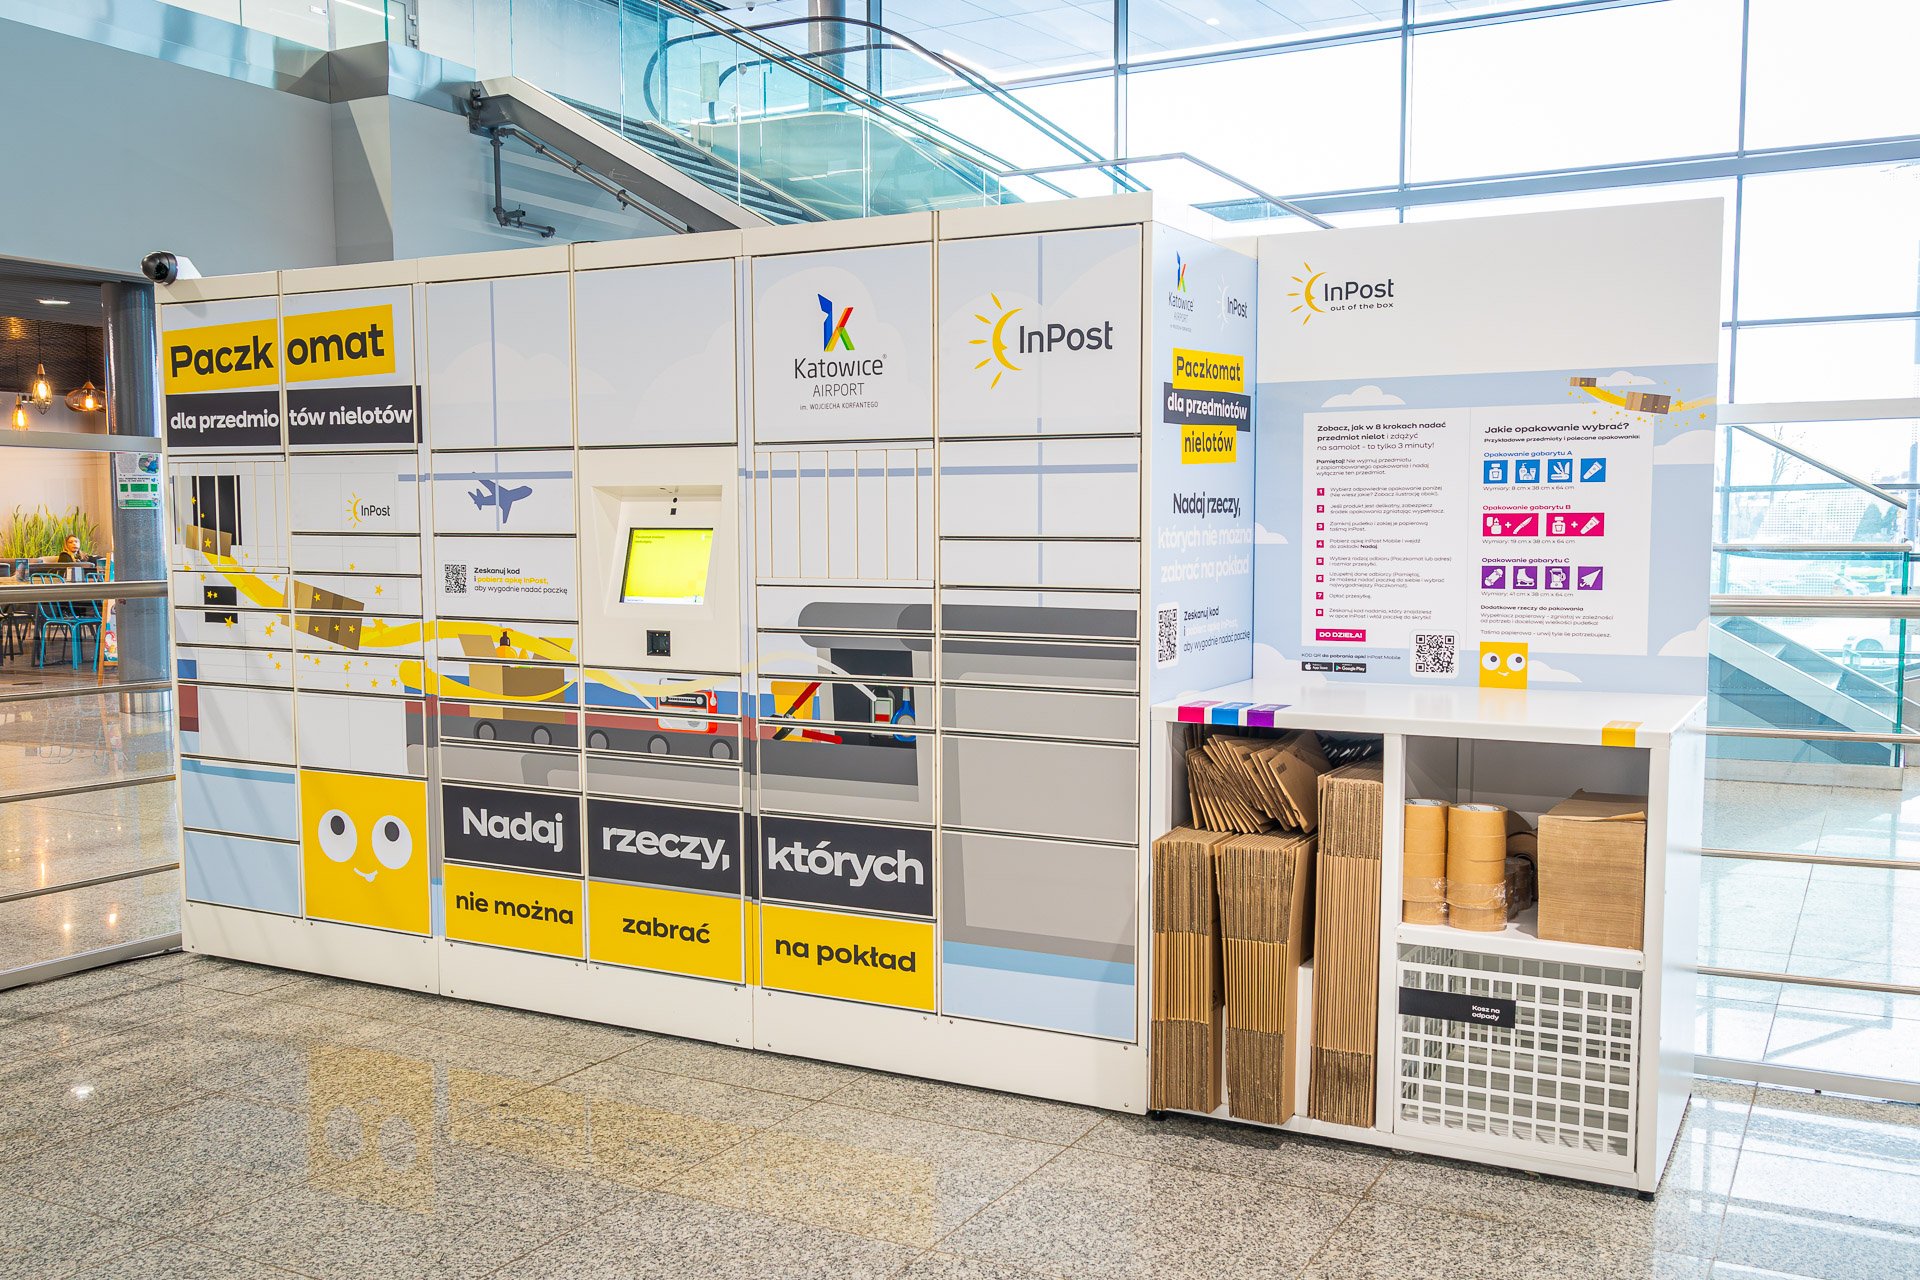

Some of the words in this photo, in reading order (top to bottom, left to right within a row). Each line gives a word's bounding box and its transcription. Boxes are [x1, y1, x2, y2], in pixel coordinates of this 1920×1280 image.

[1325, 279, 1394, 301] InPost
[1228, 297, 1247, 318] InPost
[1020, 321, 1113, 353] InPost
[1177, 356, 1240, 381] Paczkomat
[813, 383, 864, 397] AIRPORT
[1168, 392, 1184, 412] dla
[1186, 398, 1247, 419] przedmiotów
[170, 412, 195, 429] dla
[329, 405, 412, 425] nielotów
[1515, 424, 1579, 434] opakowanie
[1582, 422, 1629, 432] wybrać?
[1185, 431, 1233, 452] nielotów
[361, 505, 390, 516] InPost
[1173, 491, 1205, 519] Nadaj
[1207, 498, 1240, 518] rzeczy,
[1184, 607, 1208, 620] Zeskanuj
[1209, 606, 1219, 616] kod
[462, 806, 563, 852] Nadaj
[602, 826, 729, 871] rzeczy,
[768, 837, 923, 886] których
[456, 891, 488, 912] nie
[494, 900, 573, 924] można
[622, 917, 710, 943] zabrać
[776, 939, 809, 958] na
[817, 944, 916, 972] pokład
[1472, 1012, 1499, 1021] odpady
